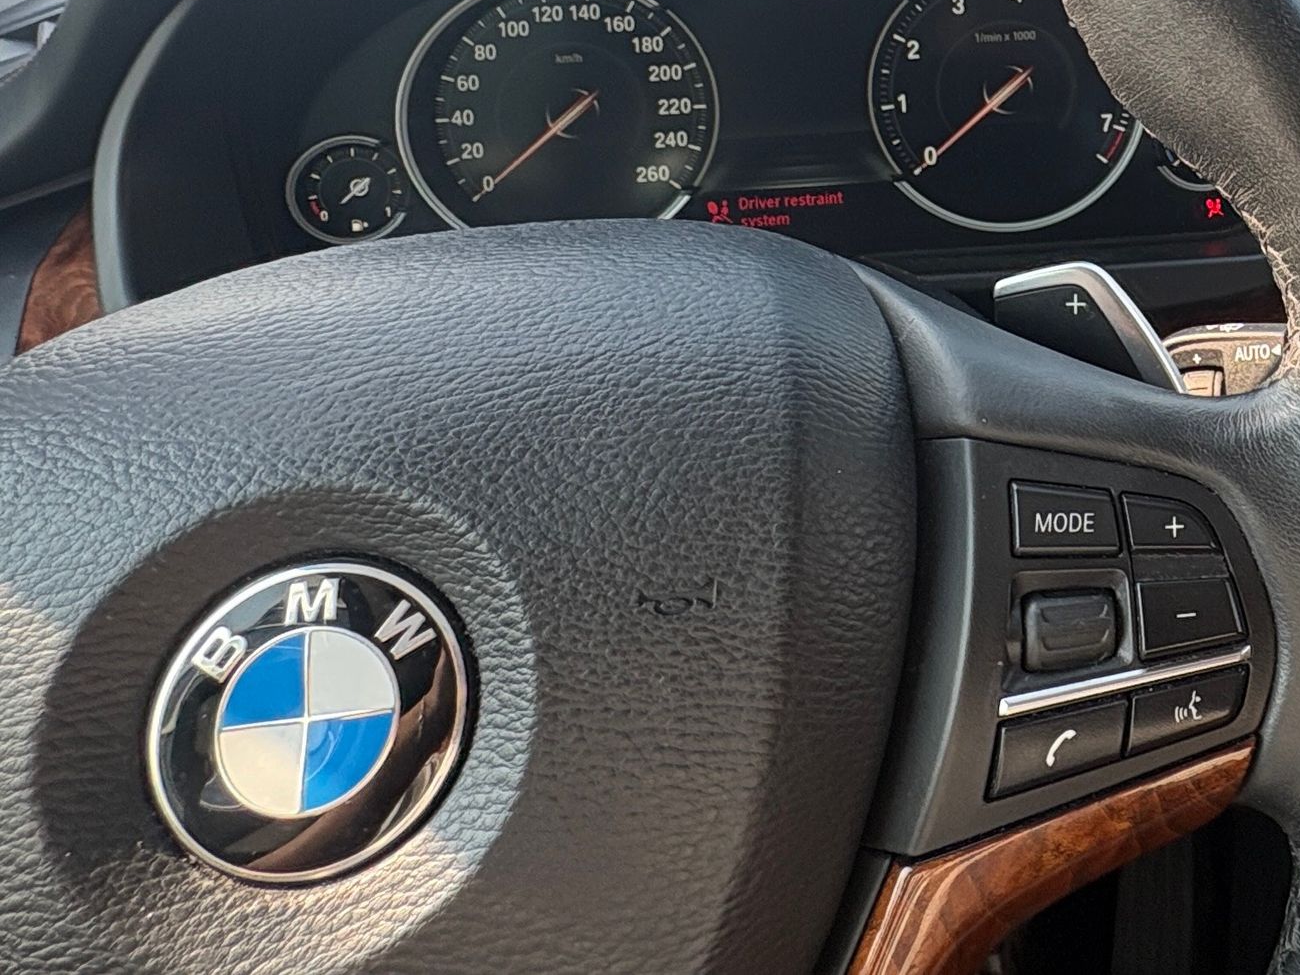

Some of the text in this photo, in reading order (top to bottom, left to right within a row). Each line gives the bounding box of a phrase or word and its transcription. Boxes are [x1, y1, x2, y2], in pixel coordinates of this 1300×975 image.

[532, 6, 563, 22] 120
[569, 4, 600, 20] 140
[499, 21, 529, 37] 100
[604, 15, 635, 33] 160
[632, 35, 664, 53] 180
[1013, 30, 1036, 41] 1000
[474, 44, 496, 61] 80
[555, 53, 583, 64] km/h
[906, 41, 921, 60] 2
[648, 64, 682, 82] 200
[456, 75, 479, 92] 60
[657, 97, 691, 115] 220
[896, 94, 908, 113] 1
[451, 109, 474, 126] 40
[1100, 113, 1113, 131] 7
[654, 130, 688, 148] 240
[461, 142, 484, 159] 20
[923, 146, 938, 166] 0
[636, 164, 670, 183] 260
[482, 175, 495, 193] 0
[738, 191, 844, 211] Driver restraint
[740, 213, 791, 228] system
[1234, 344, 1270, 363] AUTO
[1034, 512, 1095, 533] MODE
[191, 577, 438, 684] BMW
